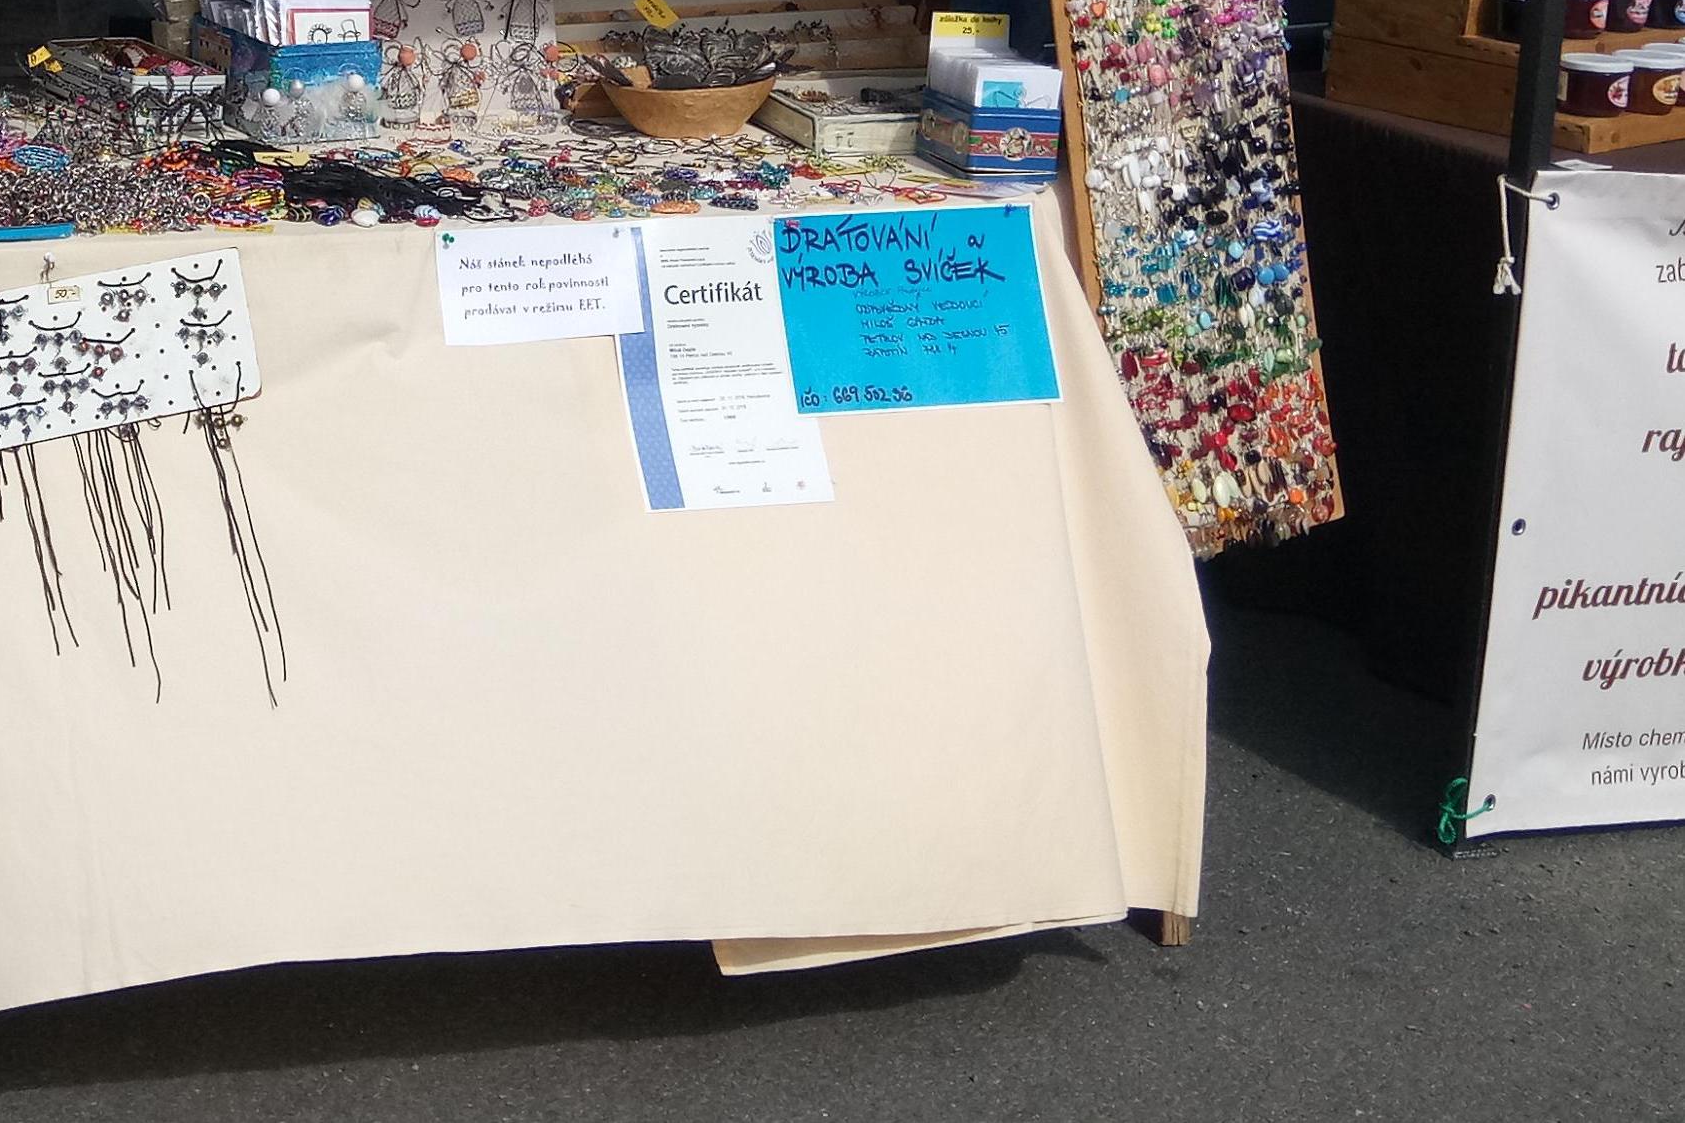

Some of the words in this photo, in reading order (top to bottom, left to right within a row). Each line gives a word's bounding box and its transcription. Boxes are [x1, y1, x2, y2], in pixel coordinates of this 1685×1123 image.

[968, 233, 985, 248] a
[459, 256, 482, 270] Náš
[487, 255, 526, 269] stánek
[531, 253, 593, 270] nepodléhá
[781, 253, 879, 292] VÝROBA
[904, 247, 1006, 284] SVÍČEK
[461, 285, 482, 297] pro
[488, 282, 520, 293] tento
[525, 277, 546, 291] rok
[549, 276, 609, 292] povinnosti
[664, 281, 763, 305] Certifikát
[464, 303, 517, 319] prodávat
[523, 305, 529, 315] v
[532, 302, 573, 315] režimu
[833, 385, 860, 404] 669
[1582, 731, 1632, 750] Místo
[1591, 763, 1634, 785] námi
